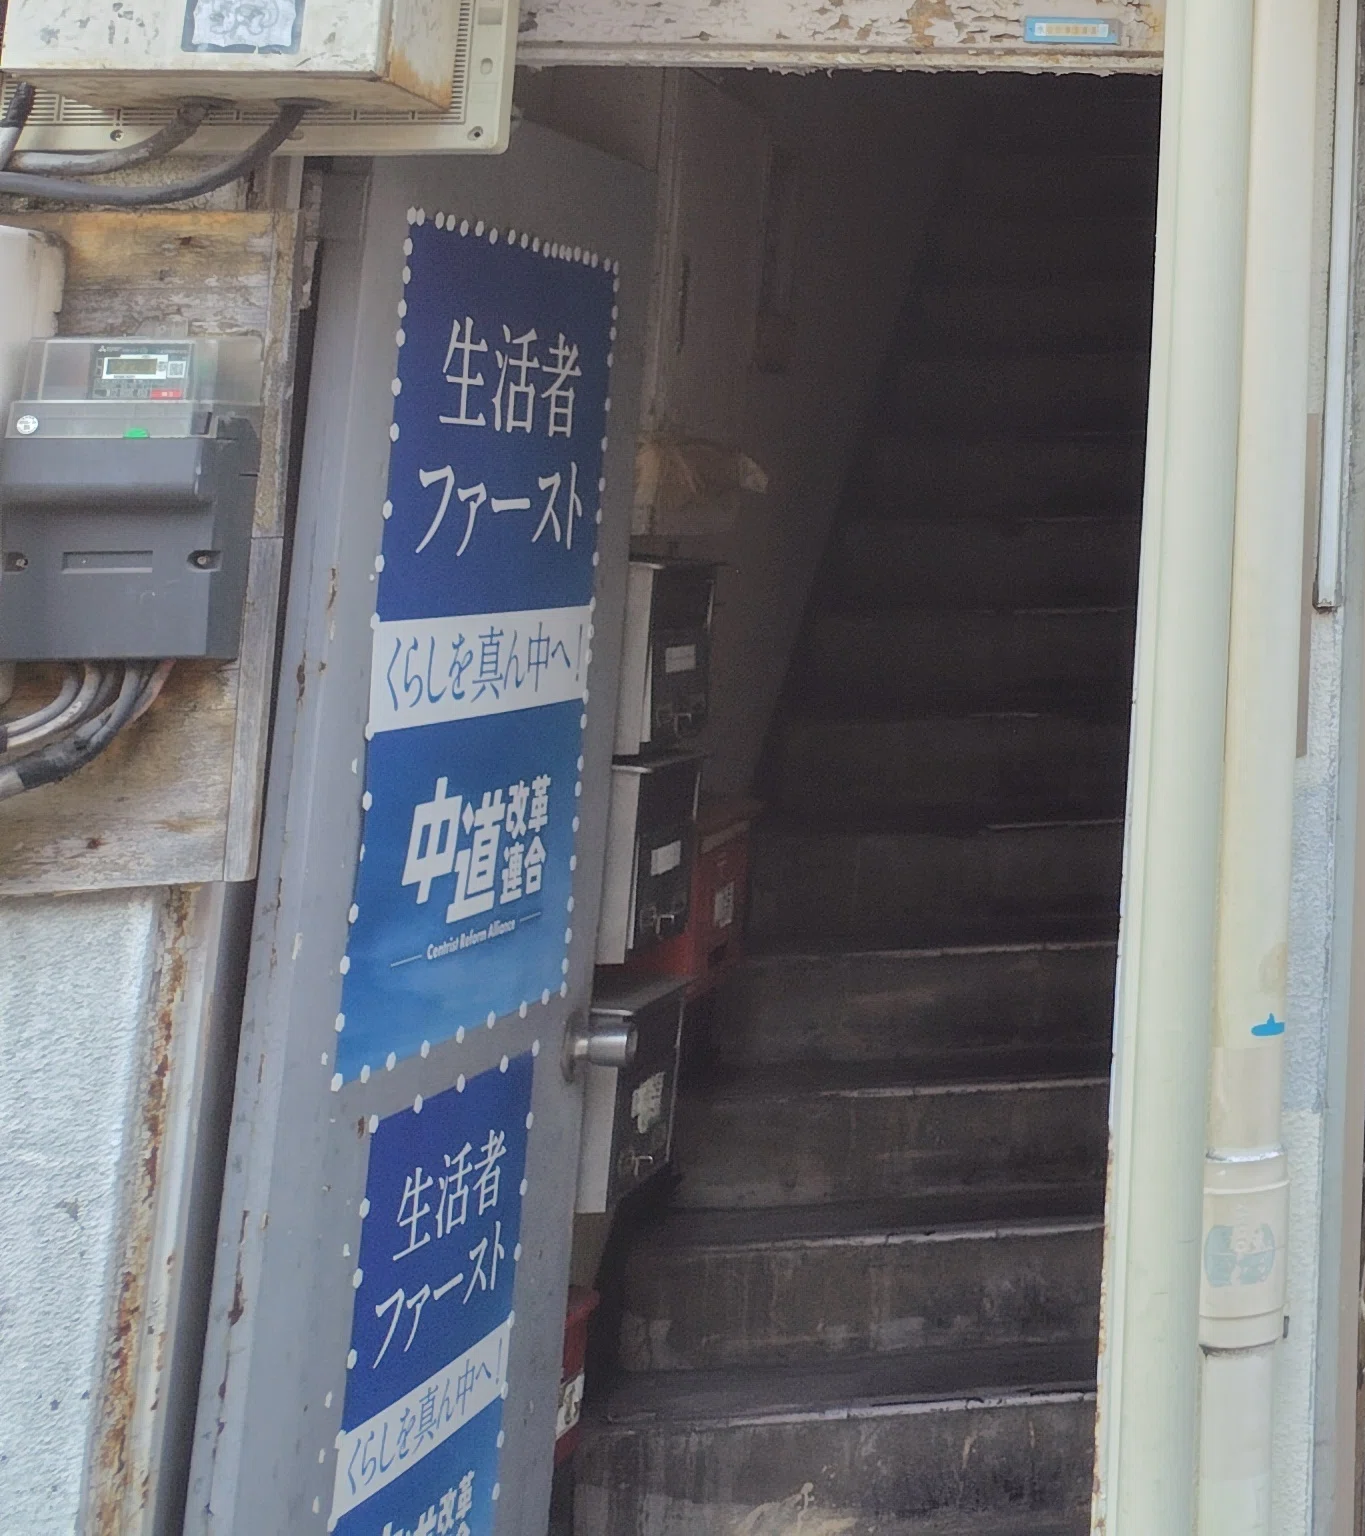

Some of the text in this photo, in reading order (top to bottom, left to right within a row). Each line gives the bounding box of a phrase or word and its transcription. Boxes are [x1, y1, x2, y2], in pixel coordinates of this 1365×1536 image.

[438, 316, 582, 439] 生活者
[417, 461, 583, 558] ファースト
[401, 776, 506, 924] 中道
[505, 773, 551, 840] 改革
[499, 835, 547, 905] 連合
[426, 918, 516, 960] Centrist Reform Alliance
[392, 1129, 508, 1262] 生活者
[372, 1222, 506, 1371] ファースト
